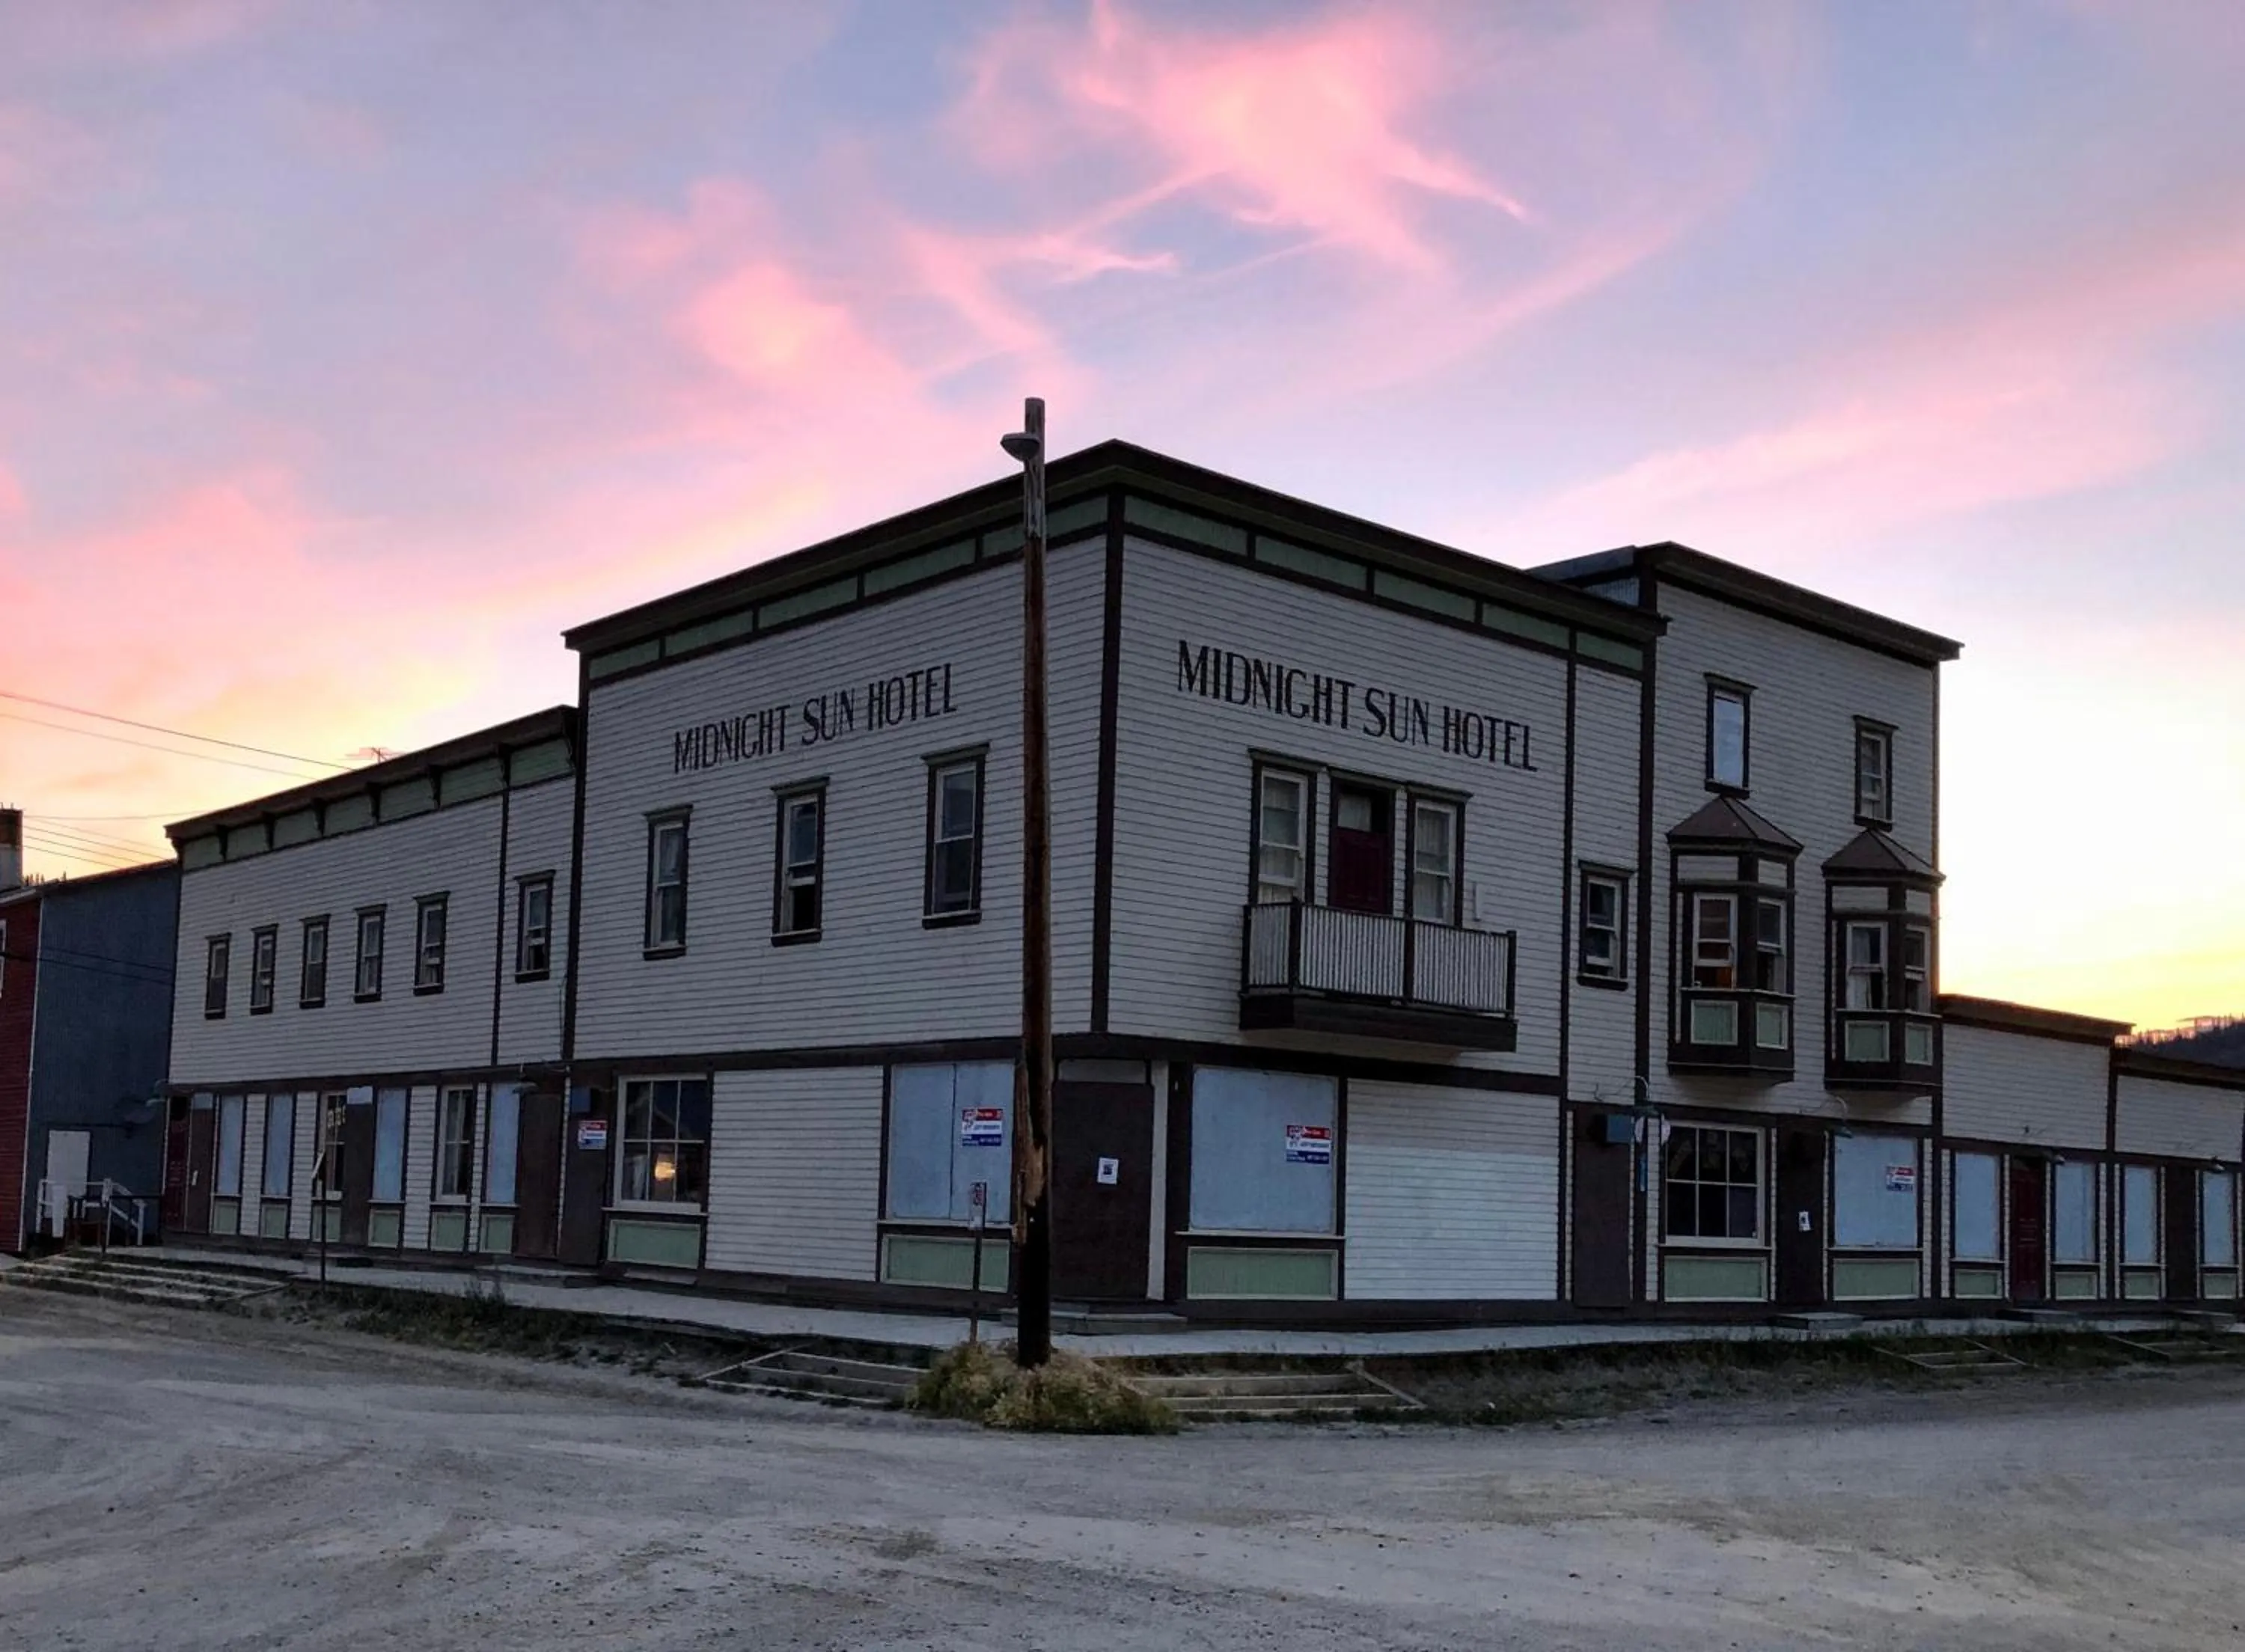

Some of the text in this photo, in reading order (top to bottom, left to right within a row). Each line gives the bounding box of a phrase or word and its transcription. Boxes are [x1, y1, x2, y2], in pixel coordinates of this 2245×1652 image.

[674, 663, 958, 774] MIDNIGHT SUN HOTEL
[1178, 640, 1538, 772] MIDNIGHT SUN HOTEL
